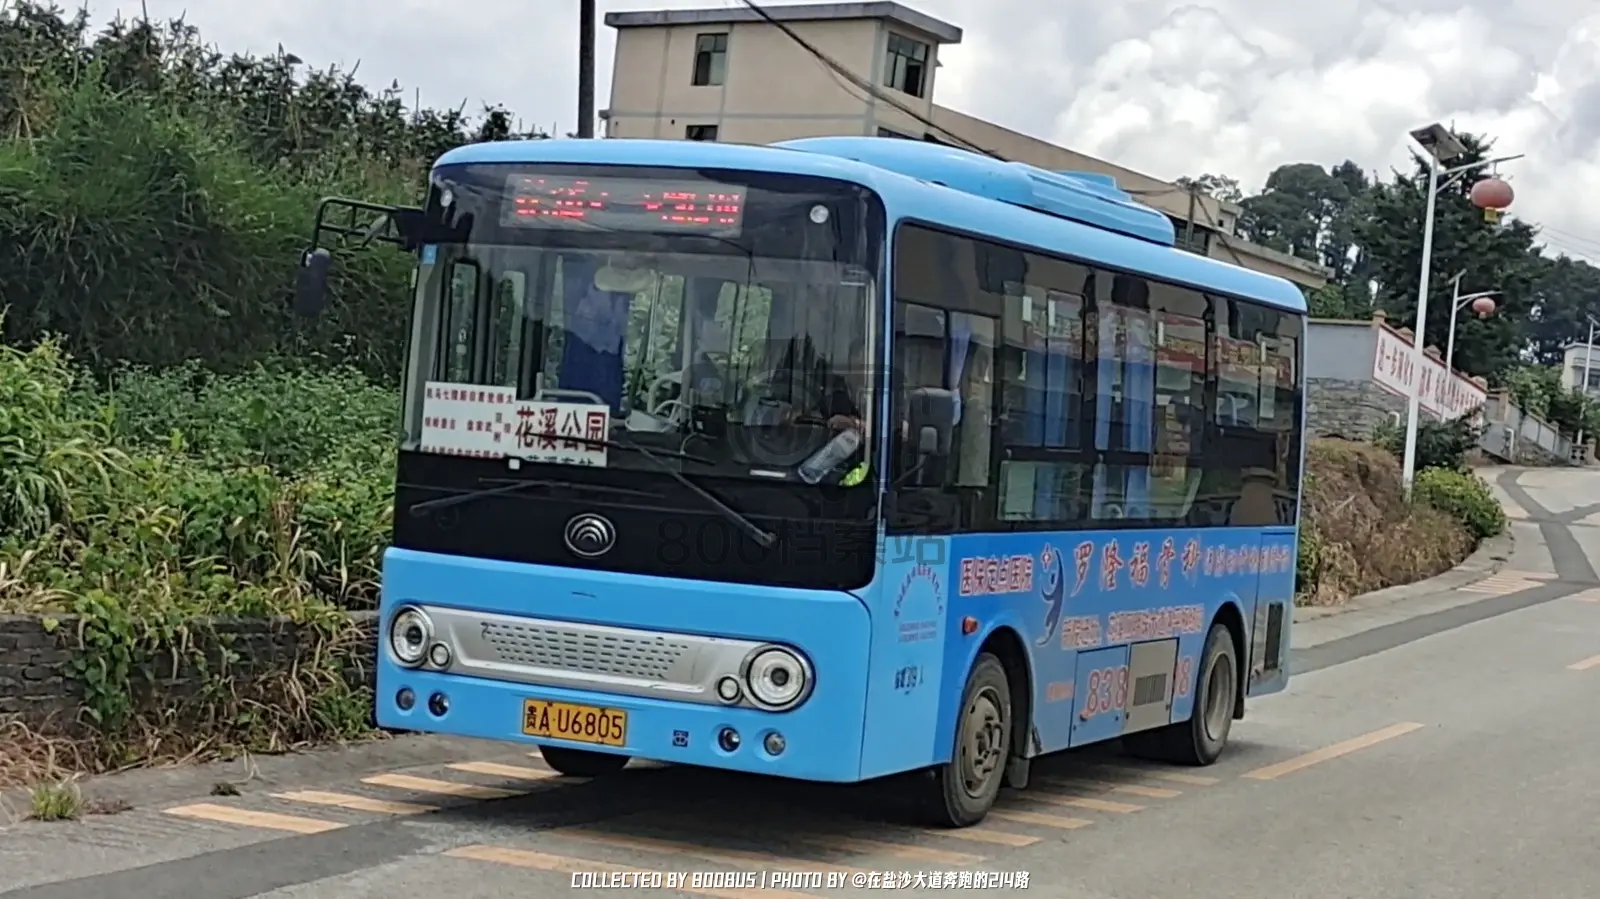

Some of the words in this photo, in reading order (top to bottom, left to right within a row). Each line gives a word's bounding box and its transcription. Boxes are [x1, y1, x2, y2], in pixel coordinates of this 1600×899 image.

[514, 404, 607, 454] 花溪公园
[959, 555, 1034, 597] 医保定点医院
[1070, 535, 1201, 597] 罗隆福骨科
